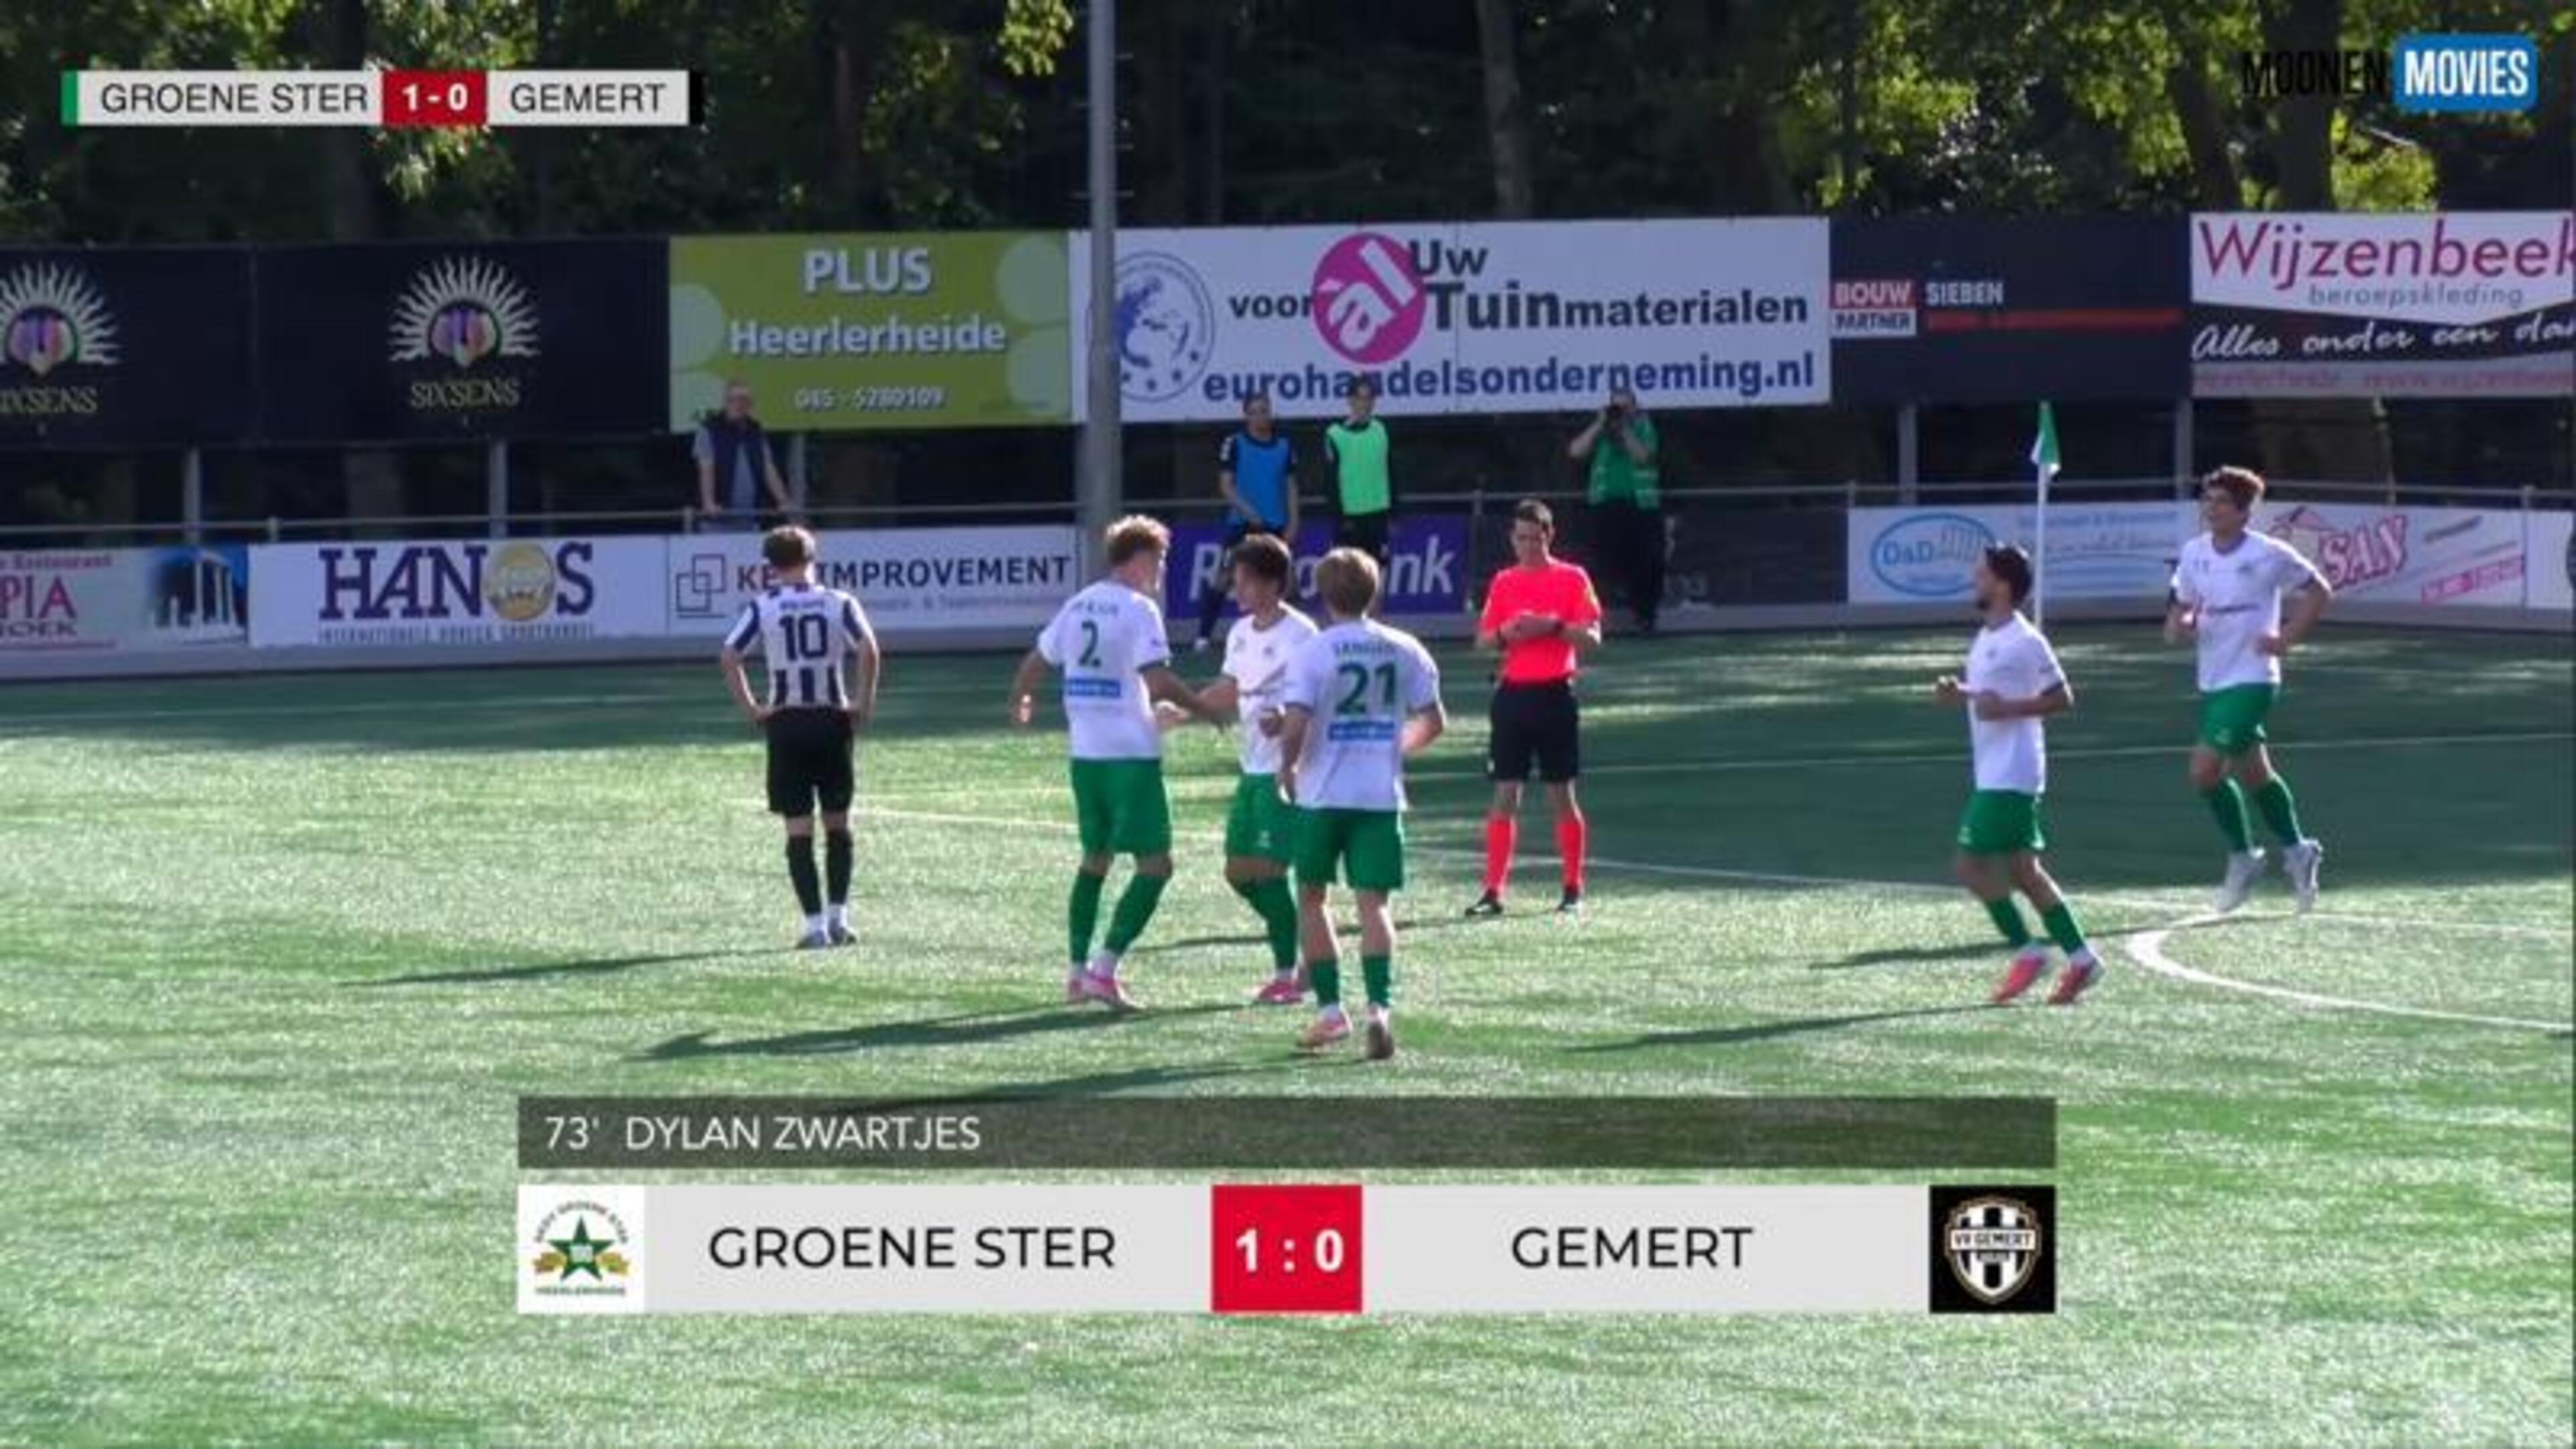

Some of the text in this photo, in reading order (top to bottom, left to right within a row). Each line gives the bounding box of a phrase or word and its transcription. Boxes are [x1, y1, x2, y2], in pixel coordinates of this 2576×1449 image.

[805, 248, 932, 293] PLUS
[1409, 240, 1488, 276] Uw
[1229, 294, 1315, 319] voor
[1424, 279, 1810, 331] Tuinmaterialen
[1835, 282, 1913, 306] BOUW
[1925, 282, 2004, 306] SIEBEN
[2309, 283, 2524, 307] beroepskleding
[730, 315, 1007, 356] Heerlerheide
[1835, 311, 1911, 331] PARTNER
[2191, 325, 2279, 358] Alles
[2301, 321, 2416, 353] onder
[2431, 327, 2501, 347] een
[411, 378, 521, 408] SIXSENS
[778, 612, 828, 661] 10
[1079, 619, 1101, 667] 2
[1336, 661, 1396, 715] 21
